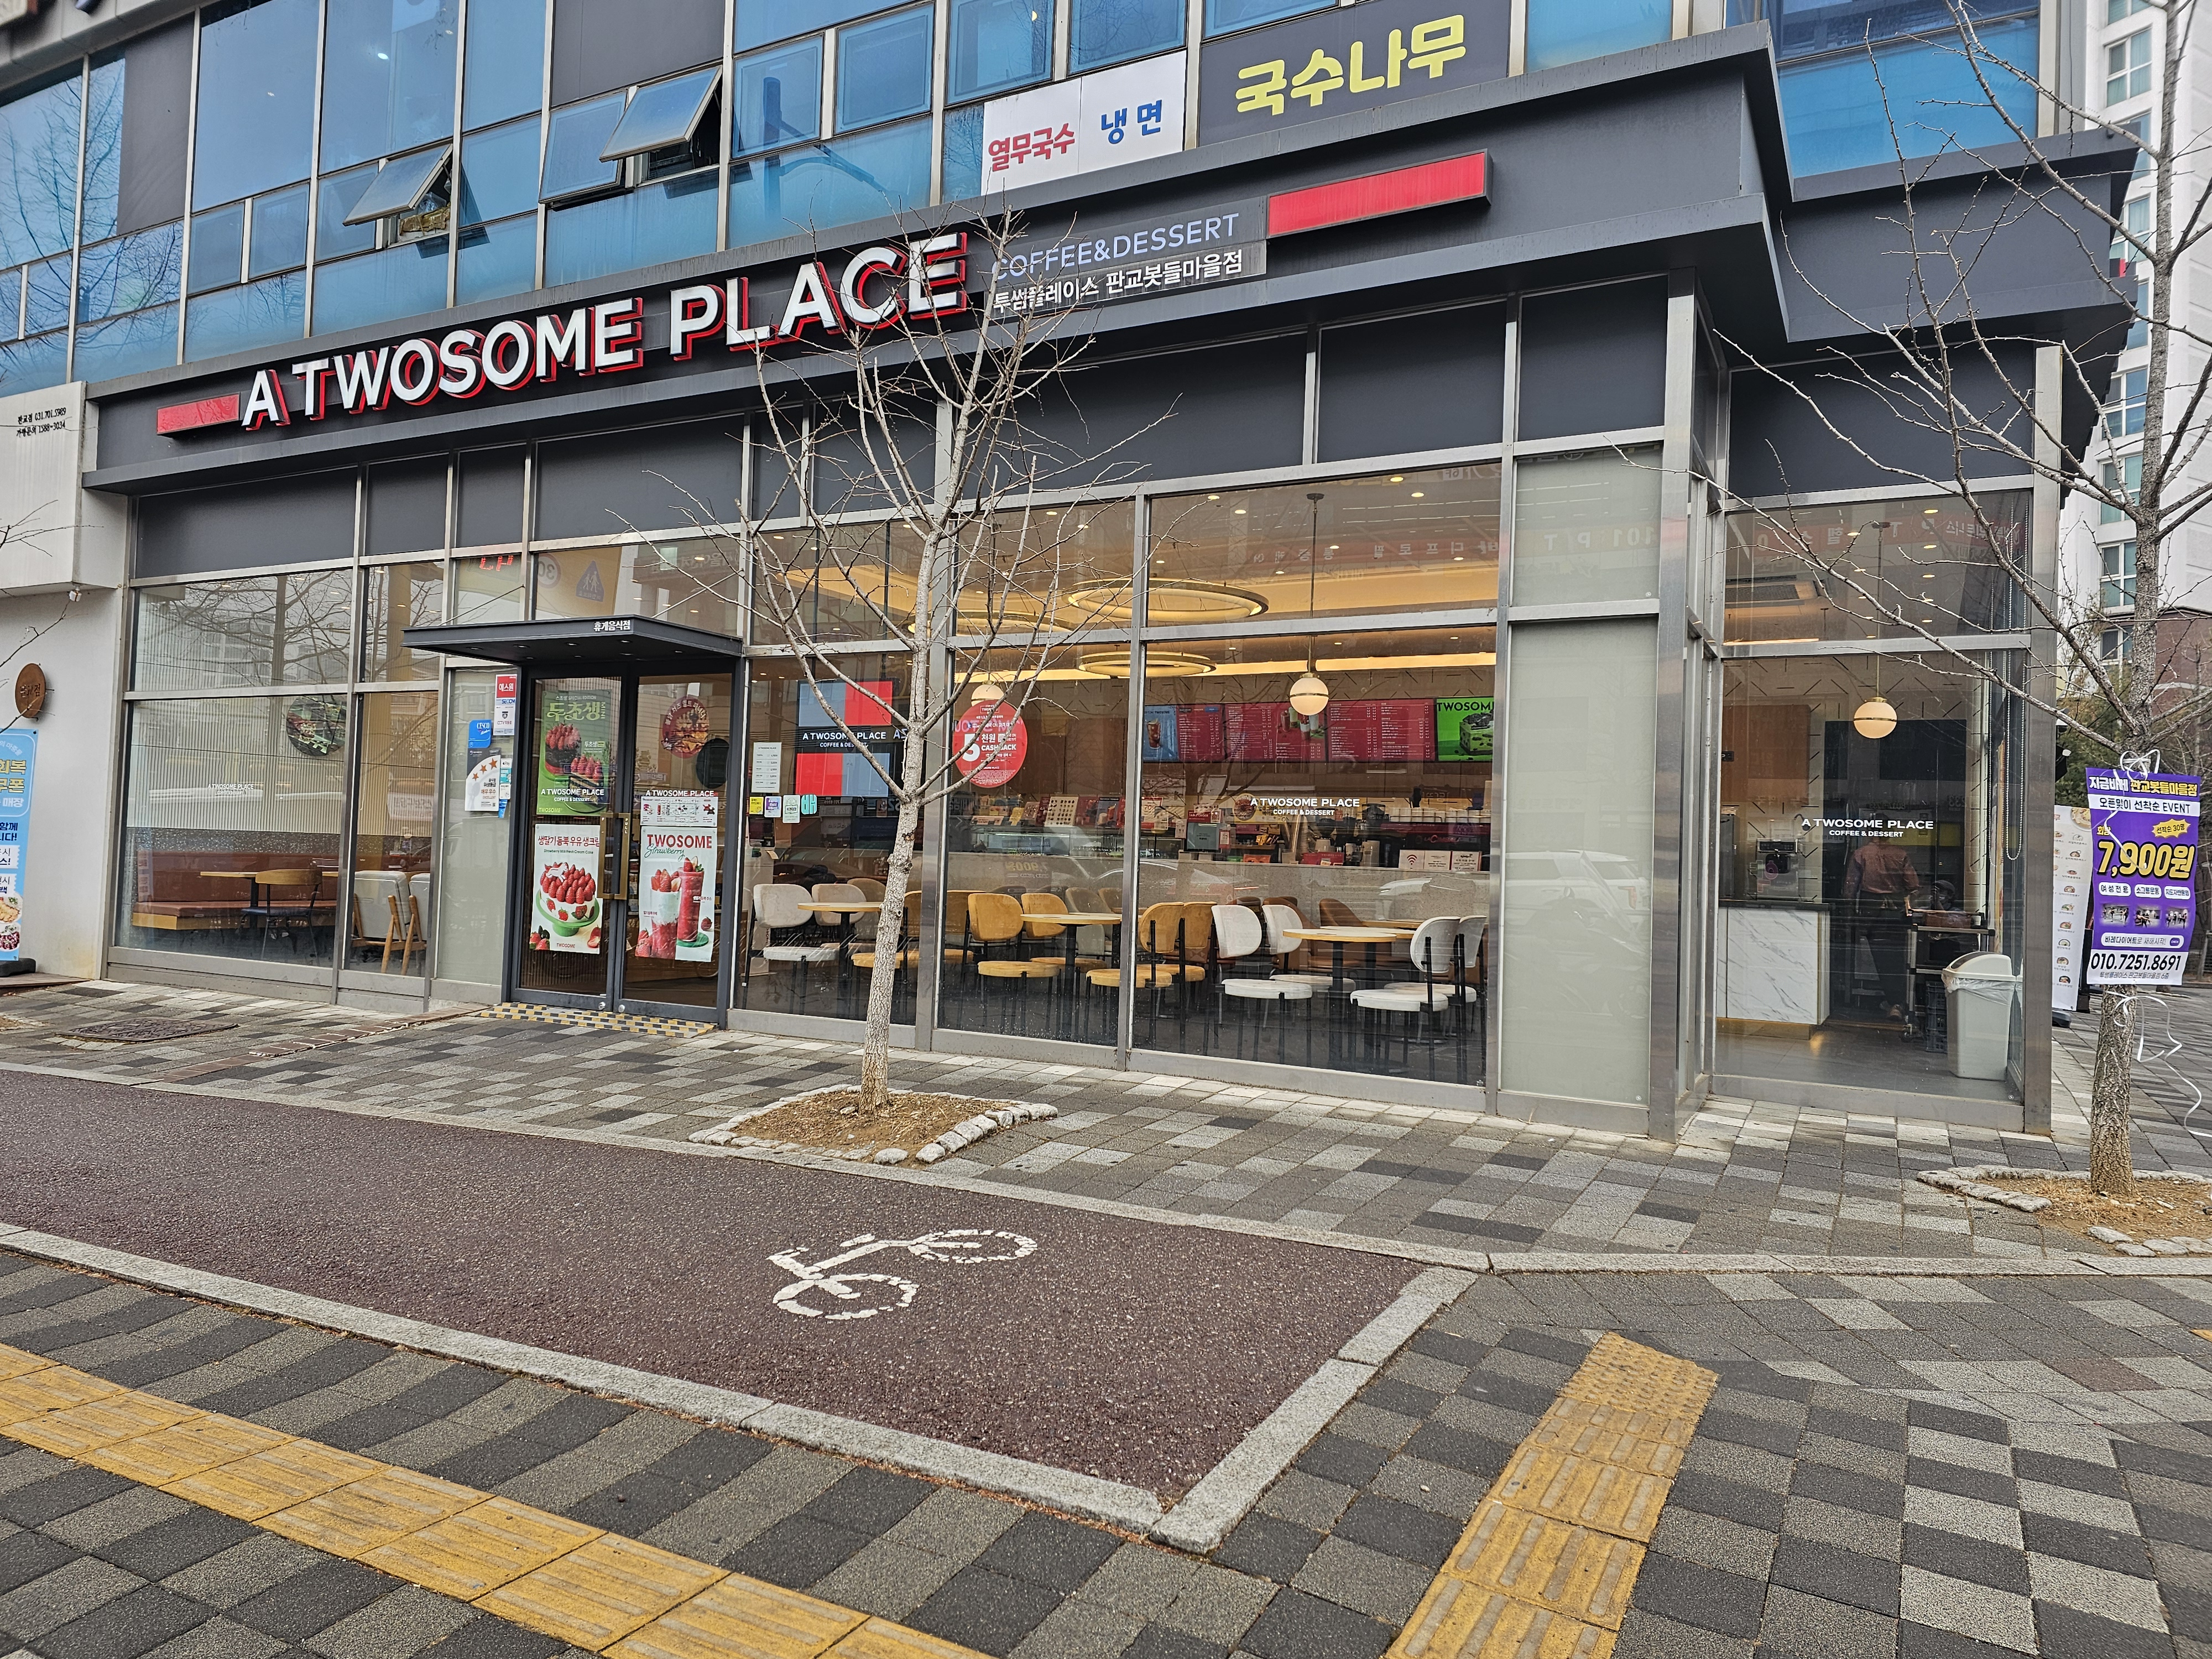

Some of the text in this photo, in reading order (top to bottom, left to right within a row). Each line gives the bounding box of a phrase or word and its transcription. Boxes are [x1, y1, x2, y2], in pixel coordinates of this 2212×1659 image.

[1236, 14, 1467, 115] 국수나무
[988, 122, 1075, 171] 열무국수
[1106, 249, 1243, 294] 판교봇들마을점
[242, 233, 968, 429] A TWOSOME PLACE
[593, 619, 631, 632] 휴게음식점
[499, 682, 514, 692] 에스원
[546, 701, 600, 721] 두초생
[1437, 701, 1494, 712] TWOSOM
[810, 732, 856, 740] TWOSOM
[962, 733, 995, 762] 5 천원
[2130, 779, 2198, 797] 판교봇들마을점
[3, 797, 24, 808] 매장
[1250, 798, 1360, 807] A TWOSOME PLACE
[2100, 797, 2190, 814] 오픈맞이 선착순 EVENT
[1801, 818, 1934, 830] A TWOSOME PLACE
[2173, 823, 2185, 832] 30명
[647, 834, 712, 849] TWOSOME
[644, 843, 685, 862] Strawberry
[2098, 841, 2195, 879] 7,900원
[2091, 953, 2182, 971] 010.7251.8691
